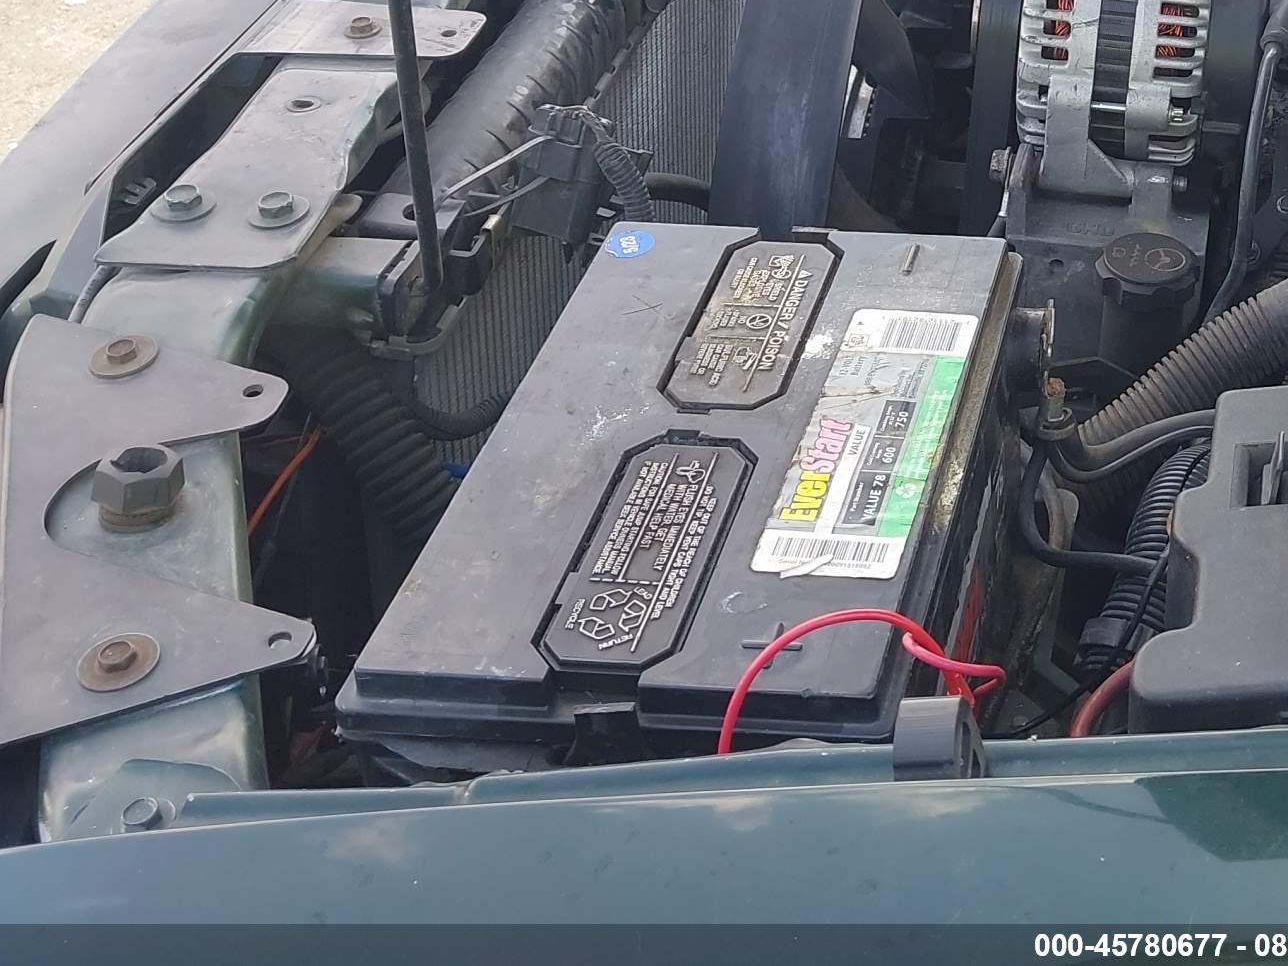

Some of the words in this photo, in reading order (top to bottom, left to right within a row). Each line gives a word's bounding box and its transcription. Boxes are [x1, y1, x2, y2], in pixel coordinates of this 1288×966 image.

[780, 280, 808, 320] DANGER
[758, 330, 786, 369] POISON
[895, 411, 909, 427] 750
[848, 430, 866, 455] VALUE
[882, 447, 896, 463] 600
[778, 417, 853, 523] EverStart
[657, 484, 676, 510] MEDICAL
[673, 484, 688, 501] WITH
[682, 484, 698, 506] FLUSH
[861, 490, 881, 520] VALUE
[873, 474, 886, 487] 78
[649, 513, 663, 530] HELP
[673, 507, 689, 523] EYES
[640, 532, 655, 548] FAST
[654, 528, 668, 541] GET
[654, 526, 680, 570] IMMEDIATELY
[564, 598, 586, 630] RECYCLE
